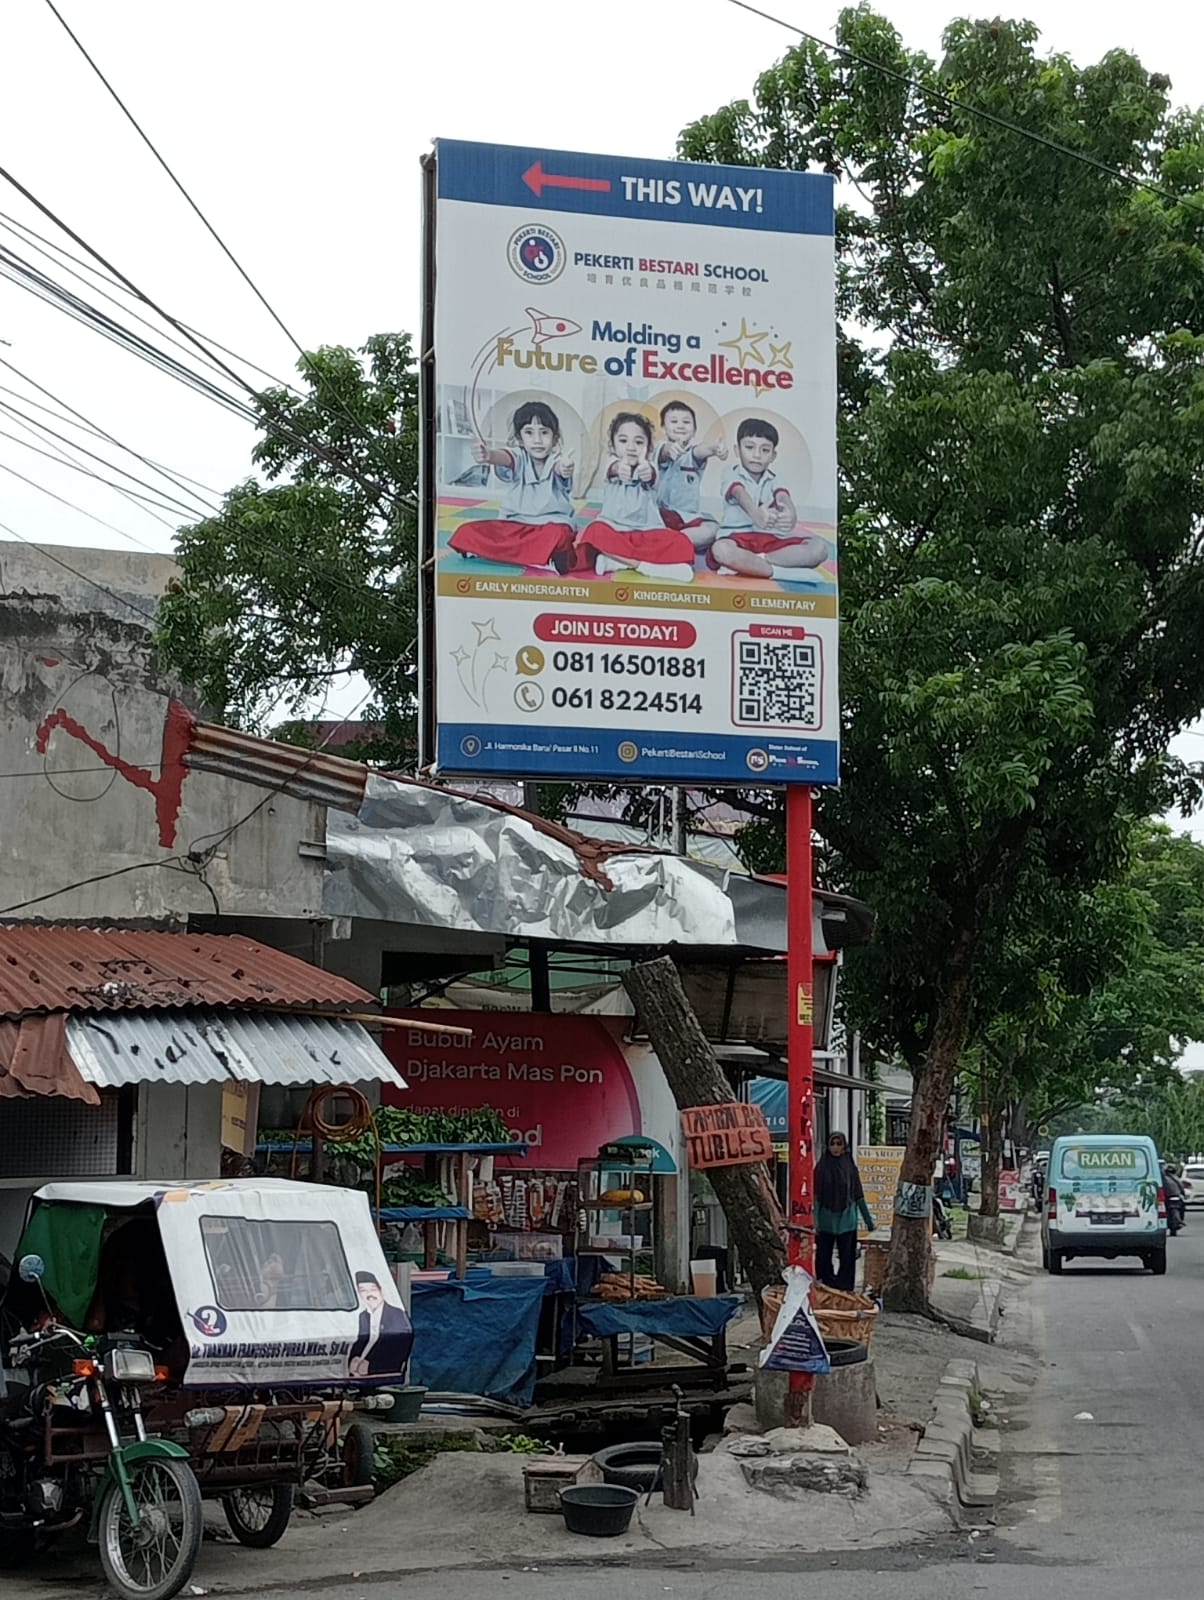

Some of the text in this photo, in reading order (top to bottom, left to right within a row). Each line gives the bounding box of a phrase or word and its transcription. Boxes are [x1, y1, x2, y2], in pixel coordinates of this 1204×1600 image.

[620, 176, 764, 213] THIS WAY!
[574, 251, 769, 283] PEKERTI BESTARI SCHOOL
[591, 320, 701, 353] Molding a
[497, 336, 794, 389] Future of Excellence
[475, 581, 589, 597] EARLY KINDERGARTEN
[633, 590, 711, 605] KINDERGARTEN
[750, 597, 816, 611] ELEMENTARY
[551, 619, 678, 641] JOIN US TODAY!
[552, 650, 705, 679] 081 16501881
[551, 686, 703, 714] 061 8224514
[408, 1030, 544, 1054] Bubur Ayam
[407, 1059, 603, 1083] Djakarta Mas Pon
[507, 1107, 520, 1119] di
[1081, 1153, 1131, 1166] RAKAN
[201, 1309, 220, 1333] 2
